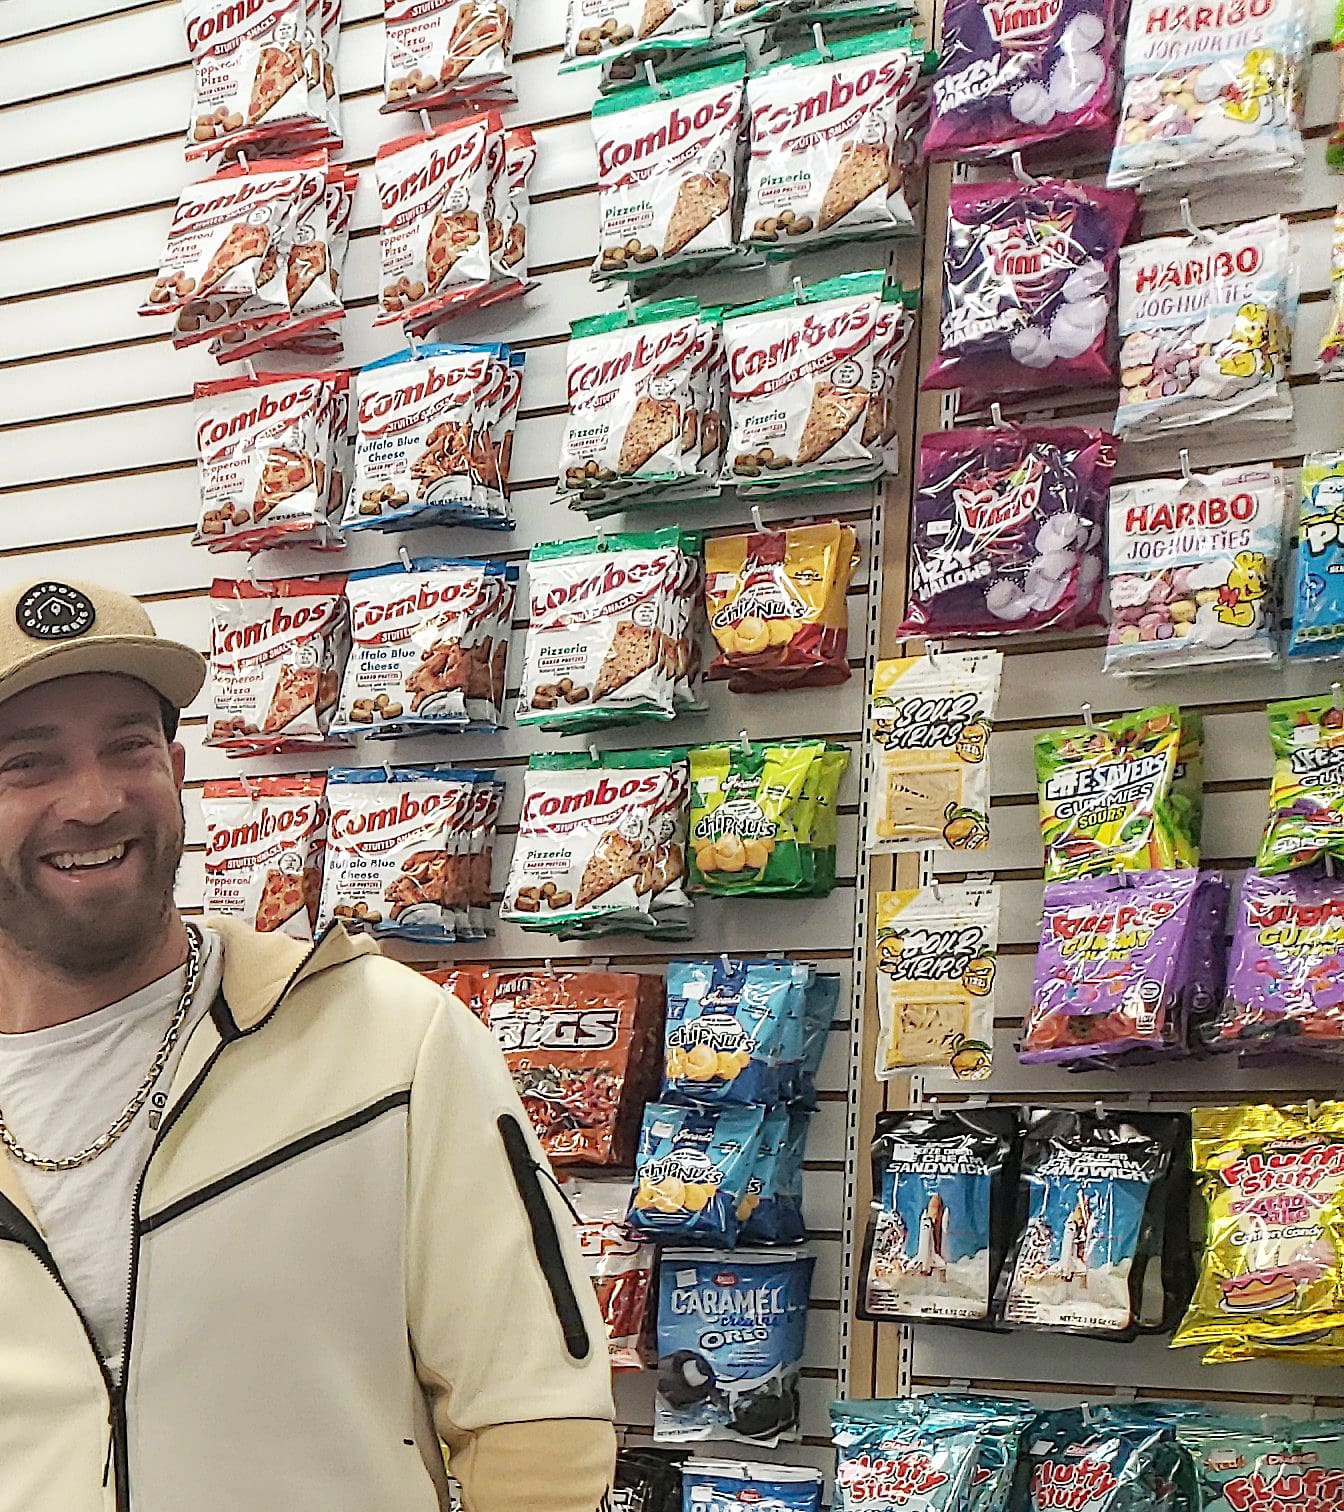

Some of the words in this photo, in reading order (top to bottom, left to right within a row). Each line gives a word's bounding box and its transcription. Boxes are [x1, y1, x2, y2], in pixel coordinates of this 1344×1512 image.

[1145, 0, 1274, 34] HARIBO
[247, 15, 276, 40] SNACKS
[749, 58, 900, 139] Combos
[760, 171, 811, 187] Pizzeria
[1135, 245, 1259, 293] HARIBO
[359, 358, 483, 423] Combos
[744, 409, 786, 428] Pizzeria
[394, 435, 420, 448] Blue
[368, 449, 405, 463] Cheese
[1124, 493, 1257, 535] HARIBO
[391, 648, 416, 659] Blue
[539, 643, 588, 656] Pizzeria
[360, 660, 400, 672] Cheese
[541, 658, 559, 666] BAKED
[897, 692, 977, 729] SOUR
[885, 723, 962, 751] STRIPS
[525, 773, 658, 822] Combos
[1055, 783, 1153, 819] GUMMIES
[331, 788, 457, 839] Combos
[1078, 806, 1126, 830] SOURS
[362, 840, 396, 854] STUFFED
[526, 848, 572, 860] Pizzeria
[371, 858, 396, 869] Blue
[205, 875, 251, 887] Pepperoni
[340, 870, 380, 880] Cheese
[213, 886, 239, 898] Pizza
[1061, 930, 1151, 956] GUMMY
[898, 957, 966, 981] STRIPS
[886, 1163, 989, 1175] SANDWICH
[925, 1155, 984, 1164] CREAM
[1242, 1168, 1325, 1195] Stuff
[1281, 1224, 1324, 1239] Candy
[671, 1286, 786, 1316] CARAMEL
[699, 1329, 769, 1349] OREO
[1036, 1486, 1090, 1509] Stuff
